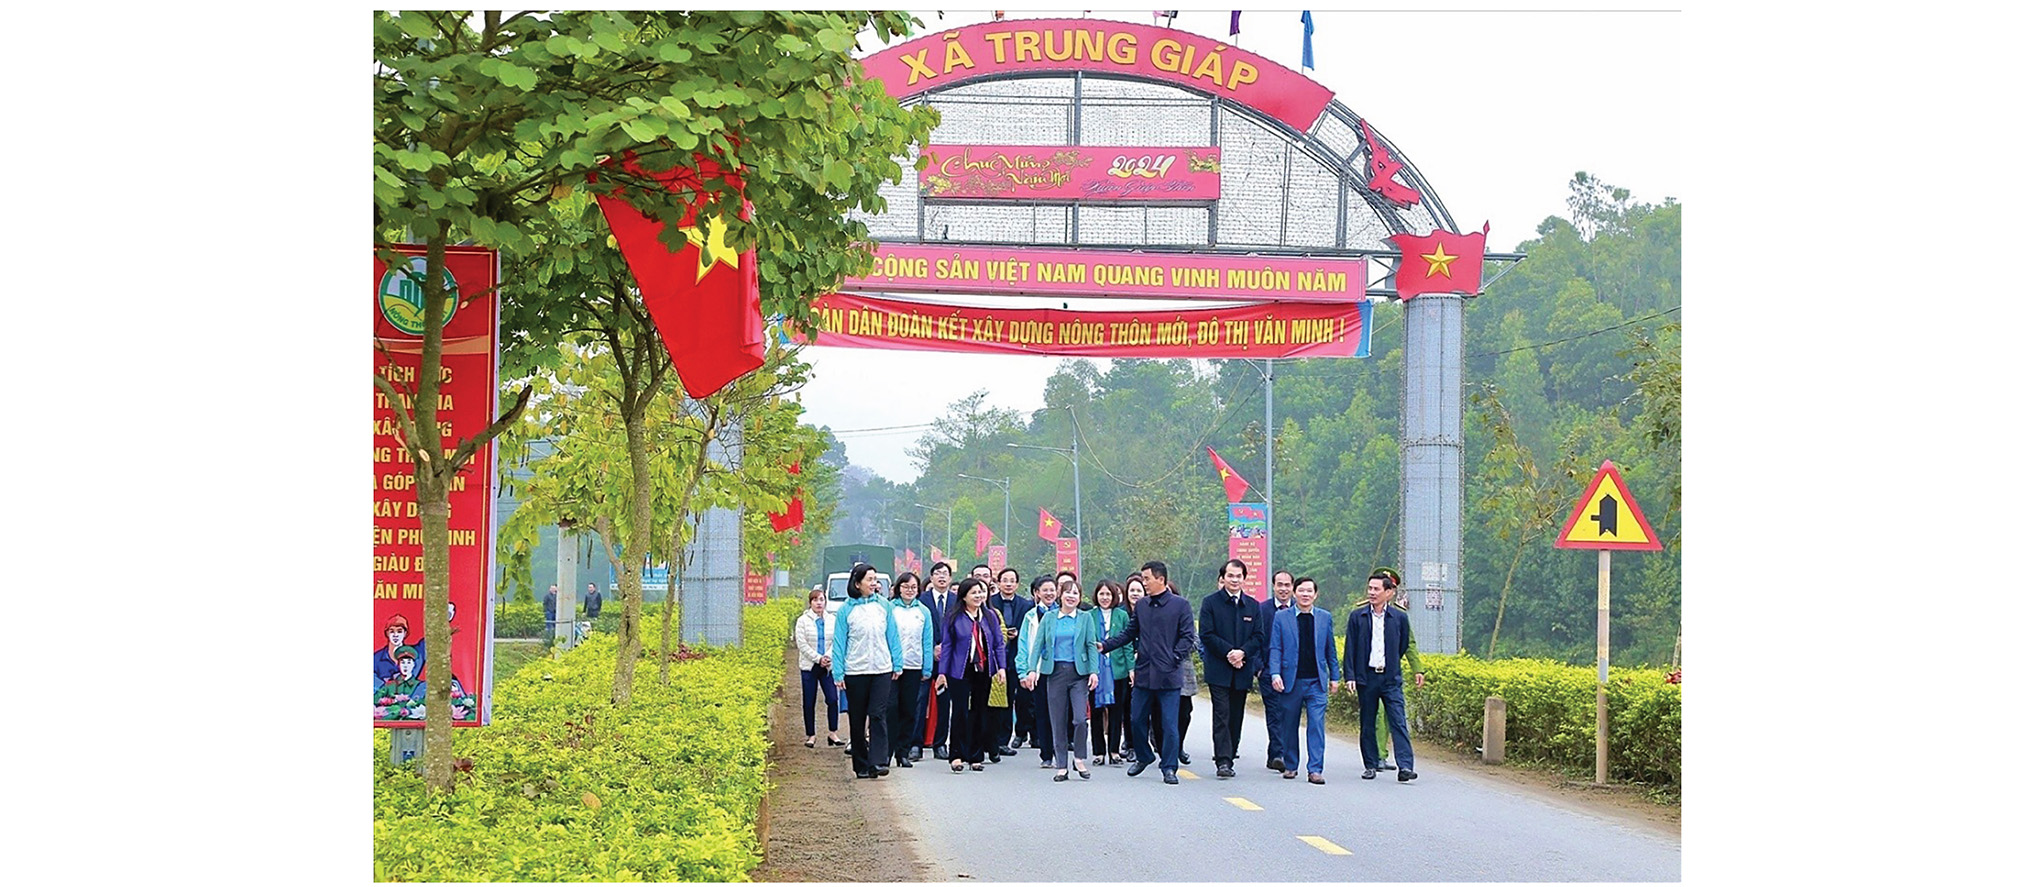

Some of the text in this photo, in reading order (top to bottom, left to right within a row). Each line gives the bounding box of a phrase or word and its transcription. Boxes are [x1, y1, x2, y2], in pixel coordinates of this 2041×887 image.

[900, 29, 1259, 91] XÃ TRUNG GIÁP
[1107, 155, 1176, 178] 2024
[872, 253, 1348, 293] CỘNG SẢN VIỆT NAM QUANG VINH MUÔN NĂM
[849, 305, 883, 337] DÂN
[887, 310, 932, 339] ĐOÀN
[938, 310, 968, 341] KẾT
[972, 316, 1004, 344] XÂY
[1009, 320, 1054, 348] DỰNG
[1058, 319, 1104, 346] NÔNG
[1110, 318, 1151, 346] THÔN
[1157, 315, 1192, 349] MỚI,
[1197, 318, 1218, 346] ĐÔ
[1224, 320, 1249, 350] THỊ
[1254, 315, 1286, 345] VĂN
[1291, 318, 1334, 344] MINH
[1340, 318, 1345, 343] !
[383, 471, 415, 491] GÓP
[374, 552, 410, 572] GIÀU
[374, 579, 398, 600] ĂN
